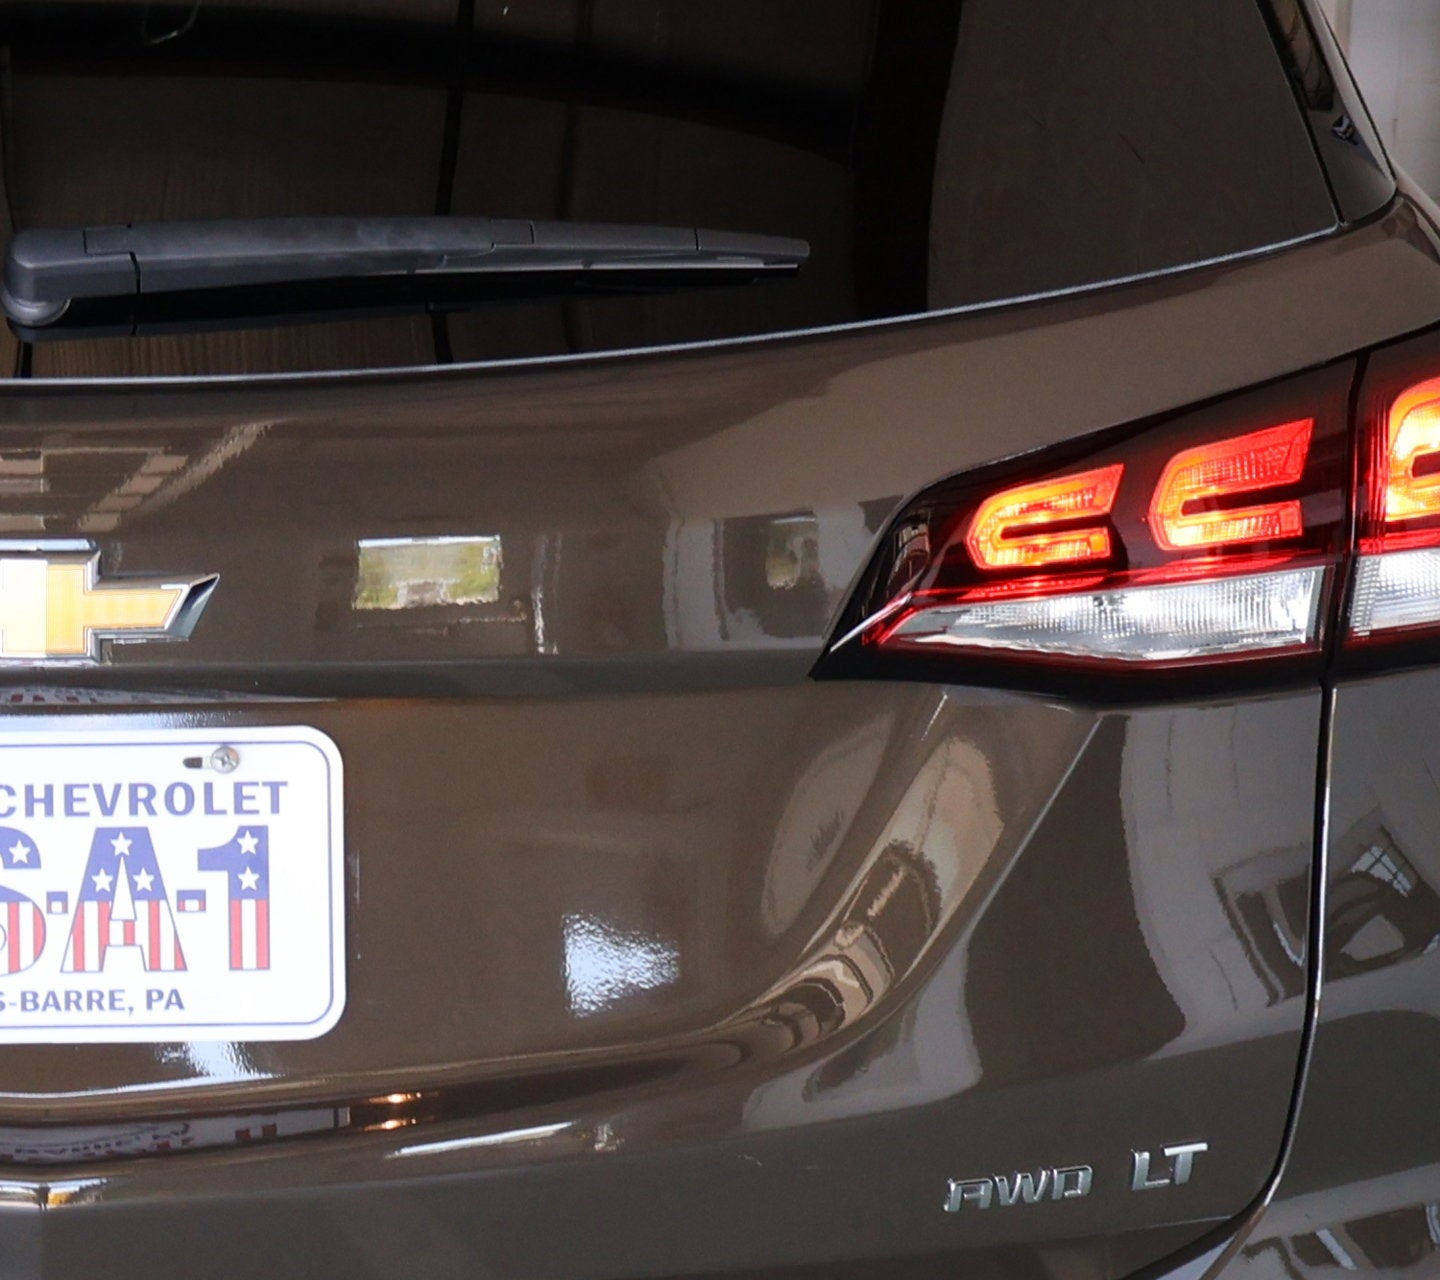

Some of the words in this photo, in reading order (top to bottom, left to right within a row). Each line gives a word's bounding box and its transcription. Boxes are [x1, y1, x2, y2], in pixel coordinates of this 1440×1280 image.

[146, 987, 186, 1012] PA
[943, 1165, 1093, 1213] AWD
[1131, 1141, 1209, 1192] LT
